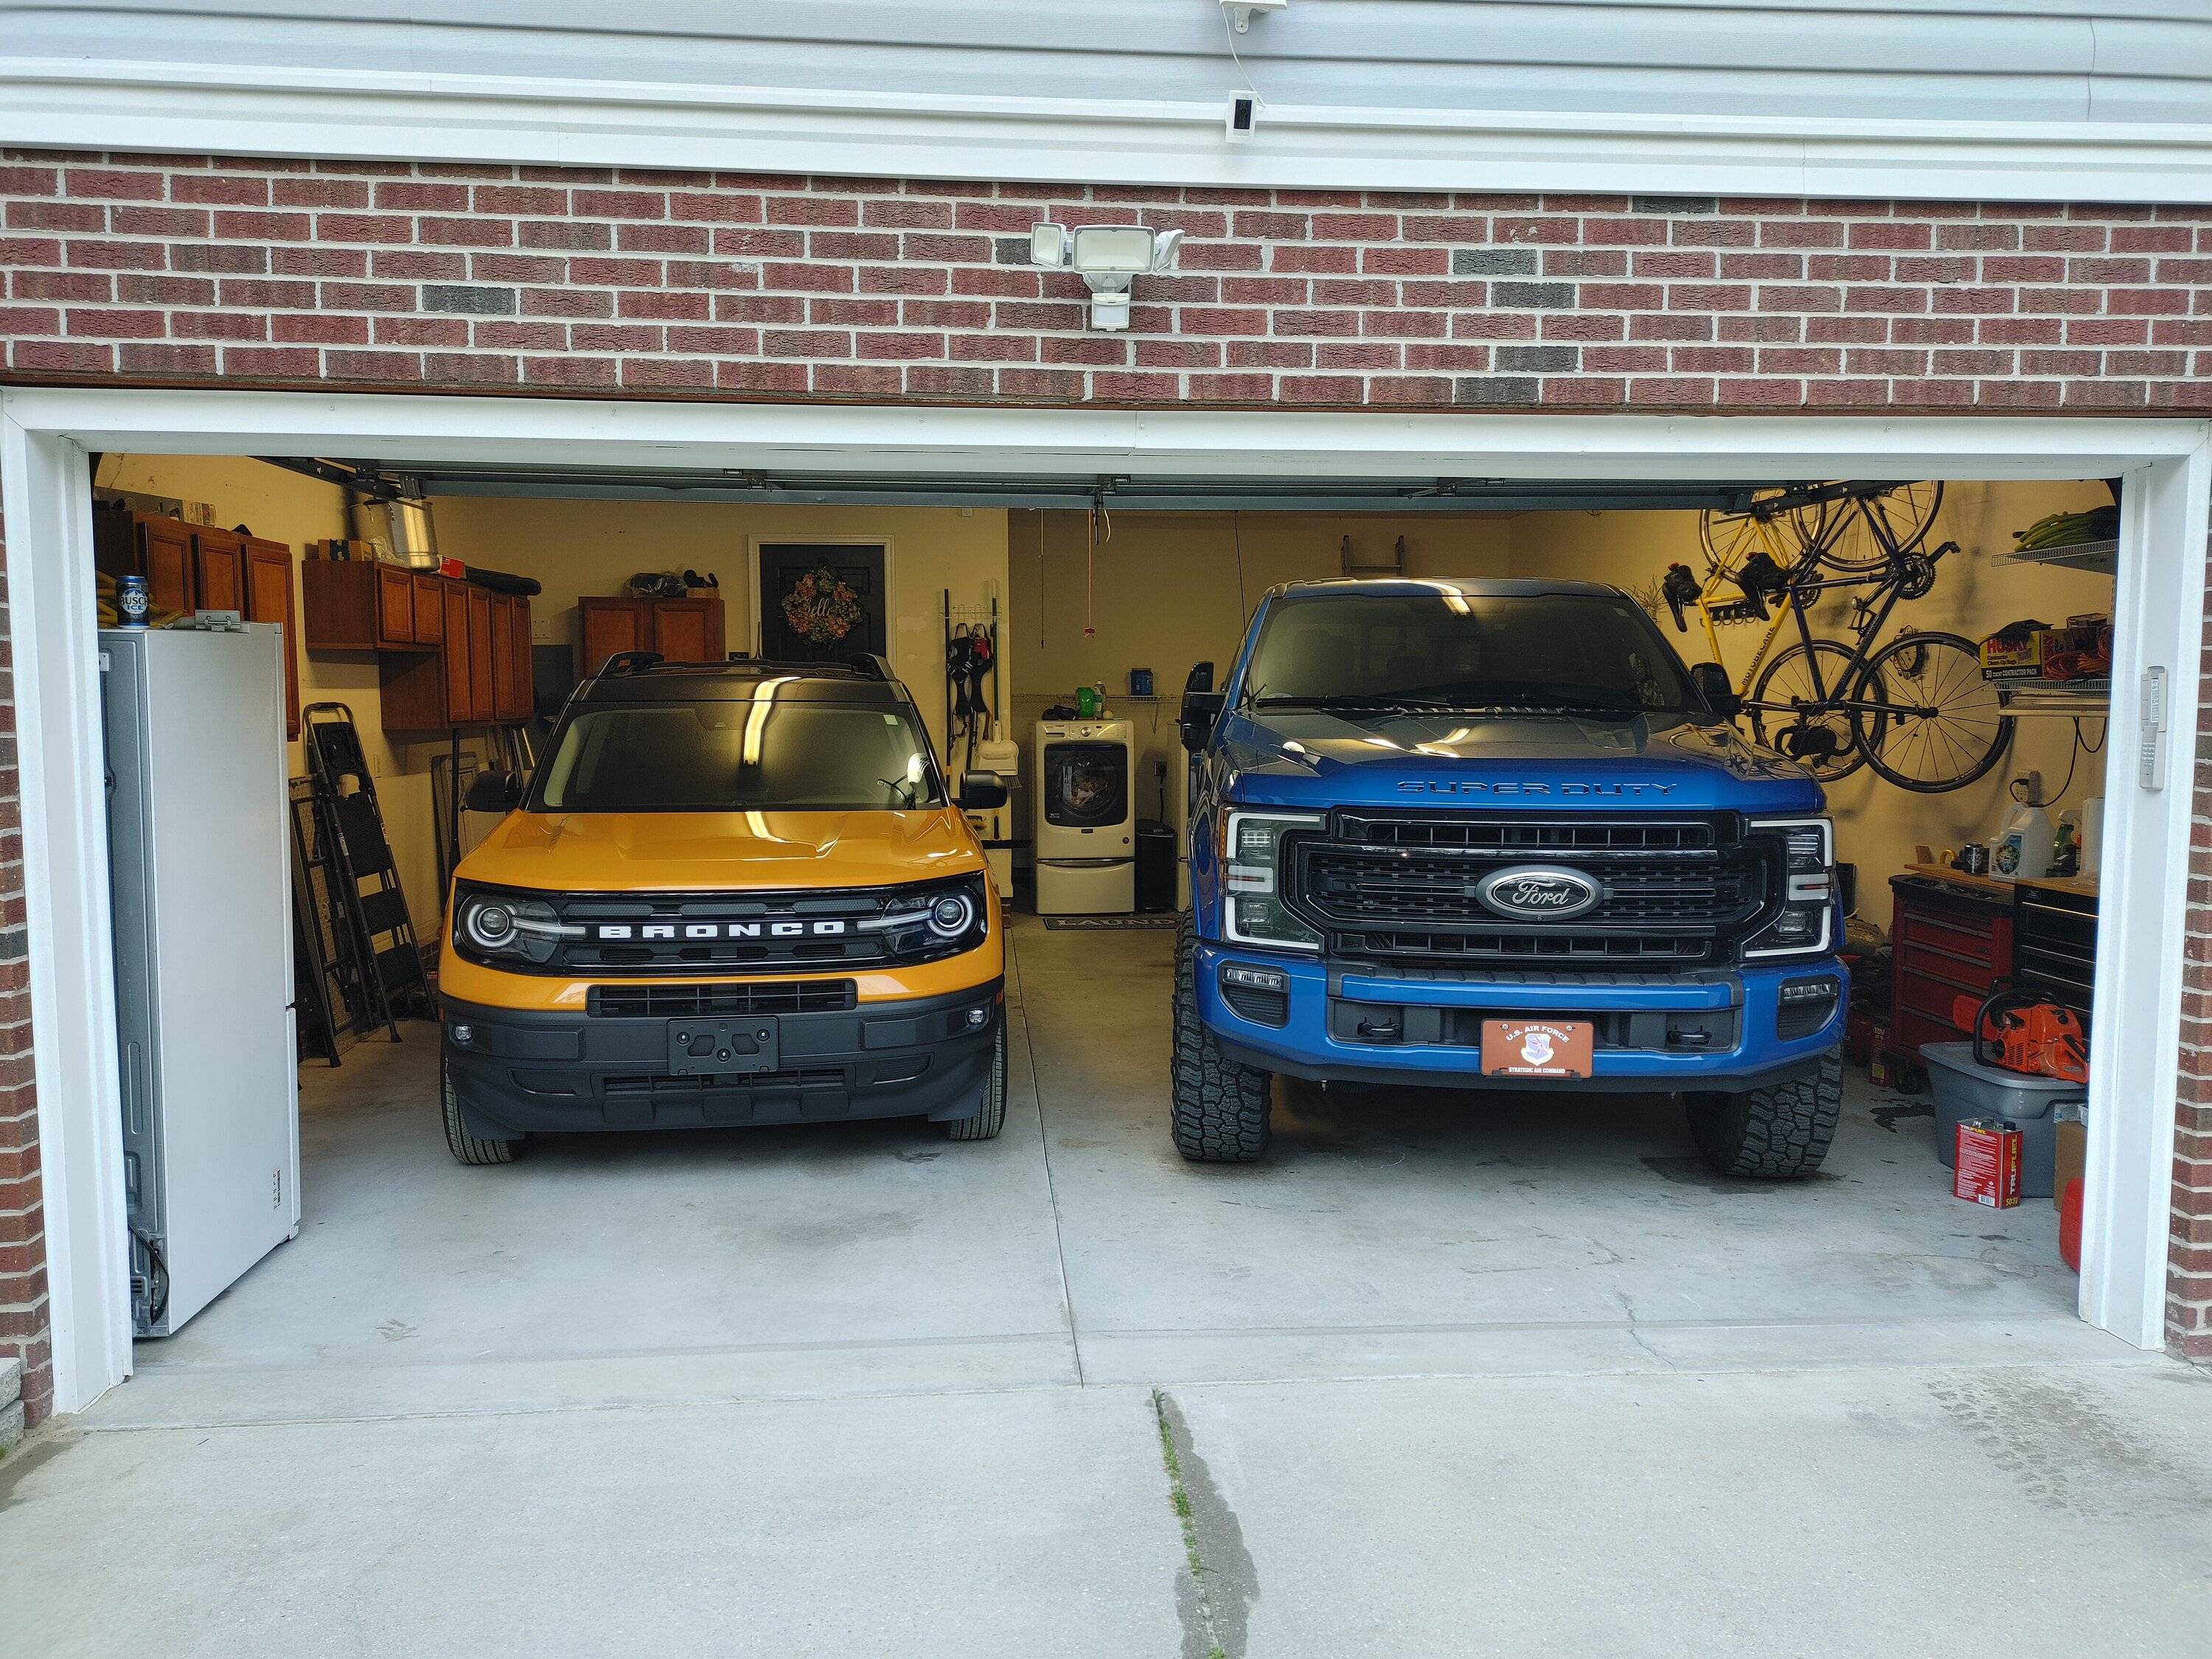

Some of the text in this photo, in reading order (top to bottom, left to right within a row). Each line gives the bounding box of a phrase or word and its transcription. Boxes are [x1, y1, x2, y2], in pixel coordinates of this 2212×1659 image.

[1741, 626, 1775, 686] MOTOBECANE
[1986, 669, 1992, 678] 50
[1397, 781, 1677, 796] SUPER DUTY
[1512, 881, 1571, 905] Ford
[599, 921, 845, 939] BRONCO
[1506, 1029, 1523, 1041] U.S.
[1541, 1026, 1571, 1043] FORCE
